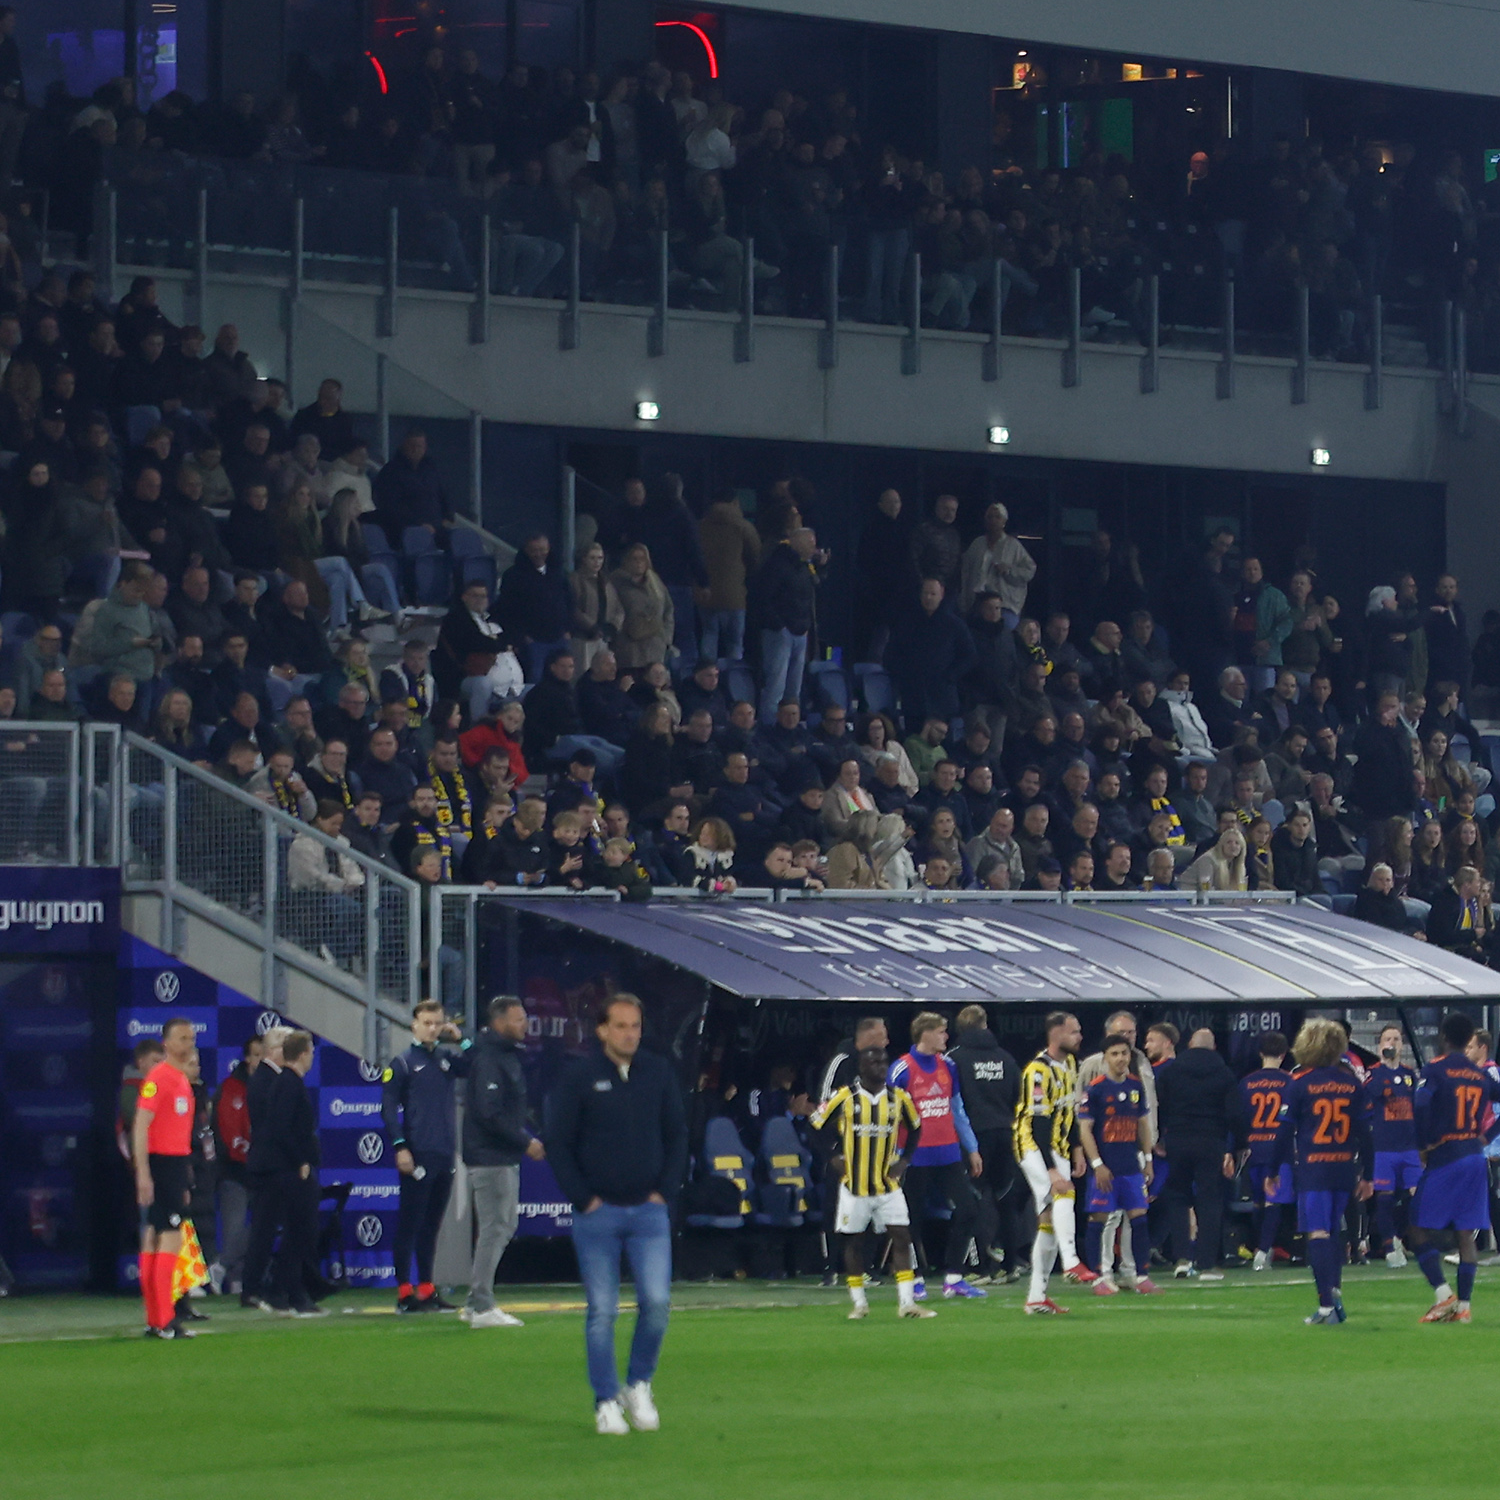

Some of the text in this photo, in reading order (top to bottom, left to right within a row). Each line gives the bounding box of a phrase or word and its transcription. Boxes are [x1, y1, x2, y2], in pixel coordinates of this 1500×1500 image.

[1250, 1091, 1281, 1129] 22
[1311, 1097, 1351, 1145] 25
[1455, 1085, 1483, 1130] 17
